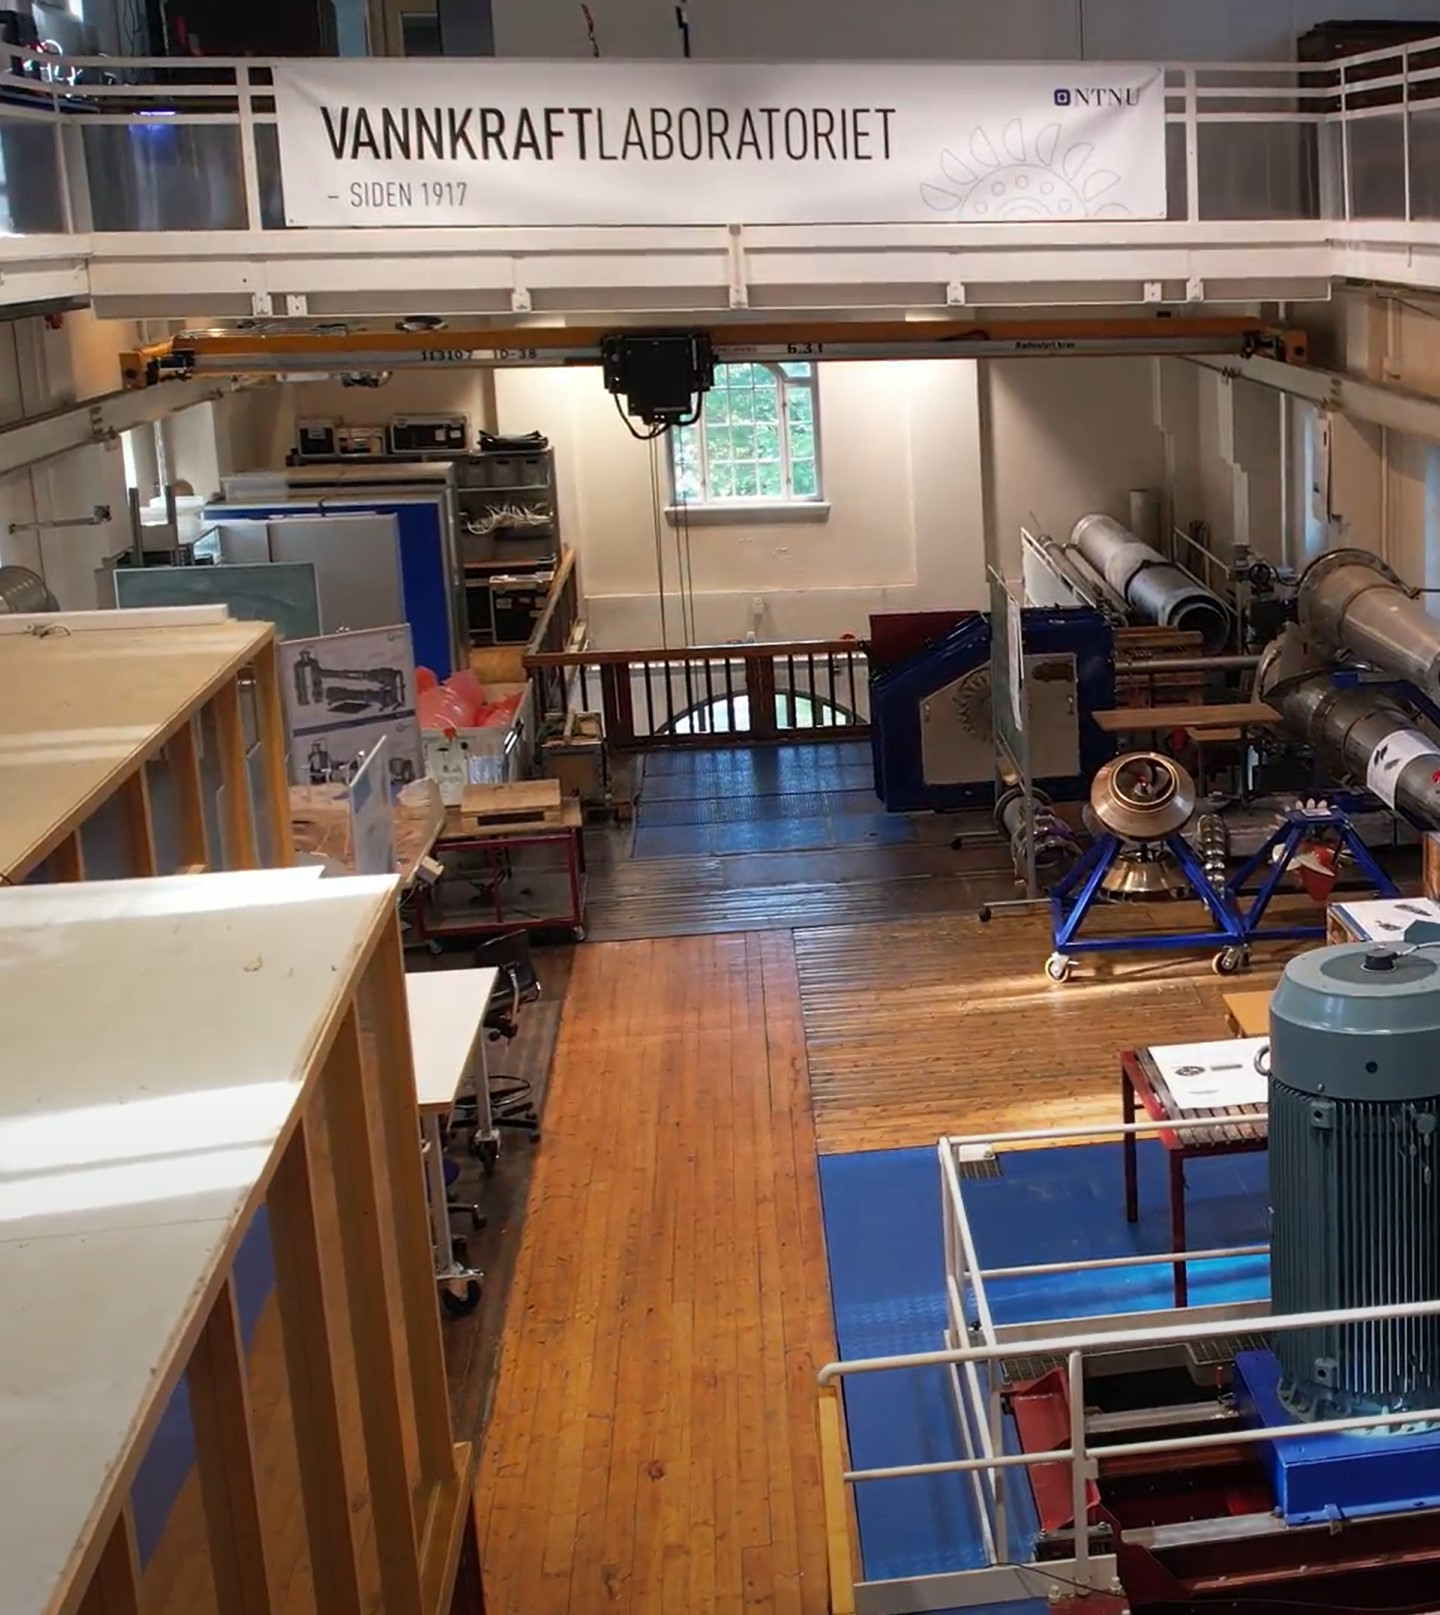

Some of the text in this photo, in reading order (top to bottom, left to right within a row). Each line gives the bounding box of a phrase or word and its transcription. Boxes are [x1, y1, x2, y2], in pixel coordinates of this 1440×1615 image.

[1074, 87, 1141, 107] NTNU
[320, 105, 896, 161] VANNKRAFTLABORATORIET
[350, 181, 413, 207] SIDEN
[421, 181, 468, 207] 1917
